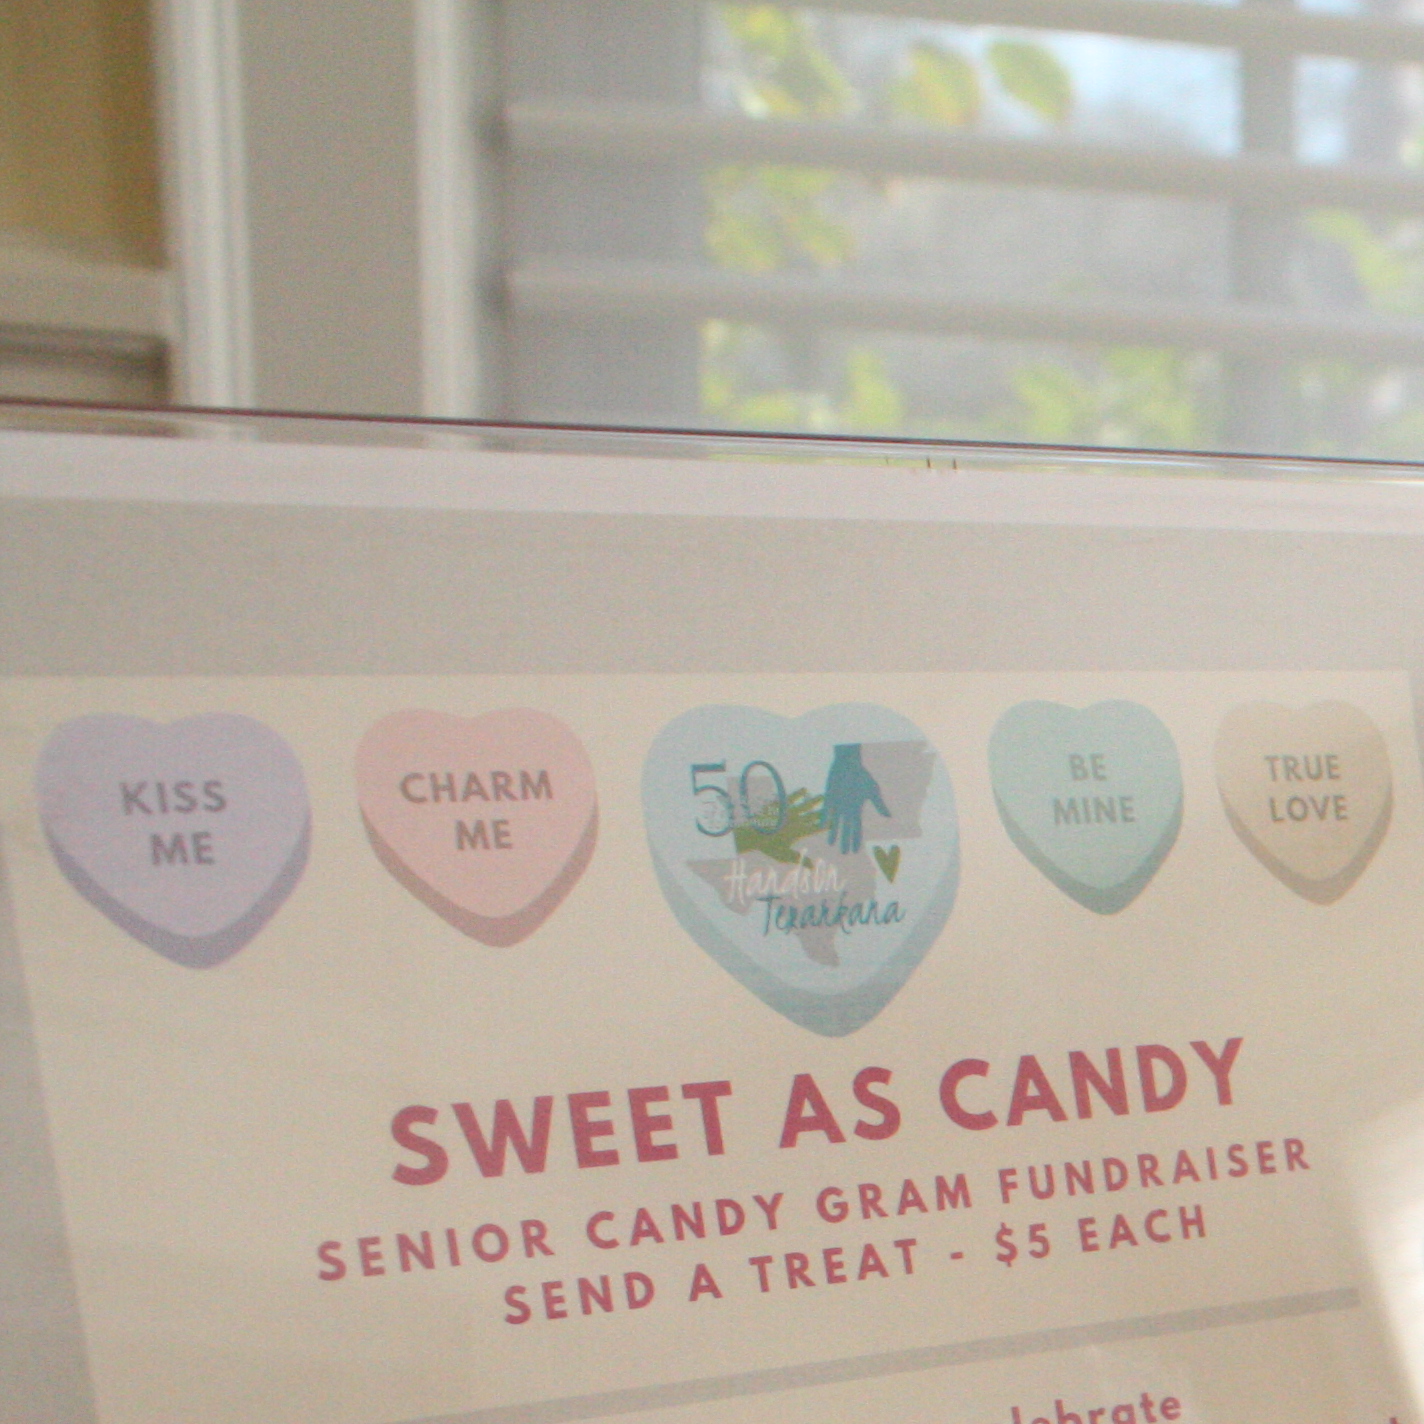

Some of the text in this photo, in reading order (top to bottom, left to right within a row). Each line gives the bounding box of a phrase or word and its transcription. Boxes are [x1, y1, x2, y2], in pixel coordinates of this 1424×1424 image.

[1069, 753, 1107, 783] BE
[1265, 753, 1342, 782] TRUE
[121, 780, 227, 815] KISS
[400, 770, 554, 804] CHARM
[690, 760, 788, 837] 50
[1053, 796, 1136, 826] MINE
[1268, 795, 1349, 823] LOVE
[151, 832, 214, 866] ME
[455, 819, 513, 851] ME
[756, 893, 906, 936] Texarkana
[390, 1037, 1243, 1187] SWEET AS CANDY
[317, 1137, 1310, 1282] SENIOR CANDY GRAM FUNDRAISER
[504, 1204, 1206, 1326] SEND A TREAT - $5 EACH
